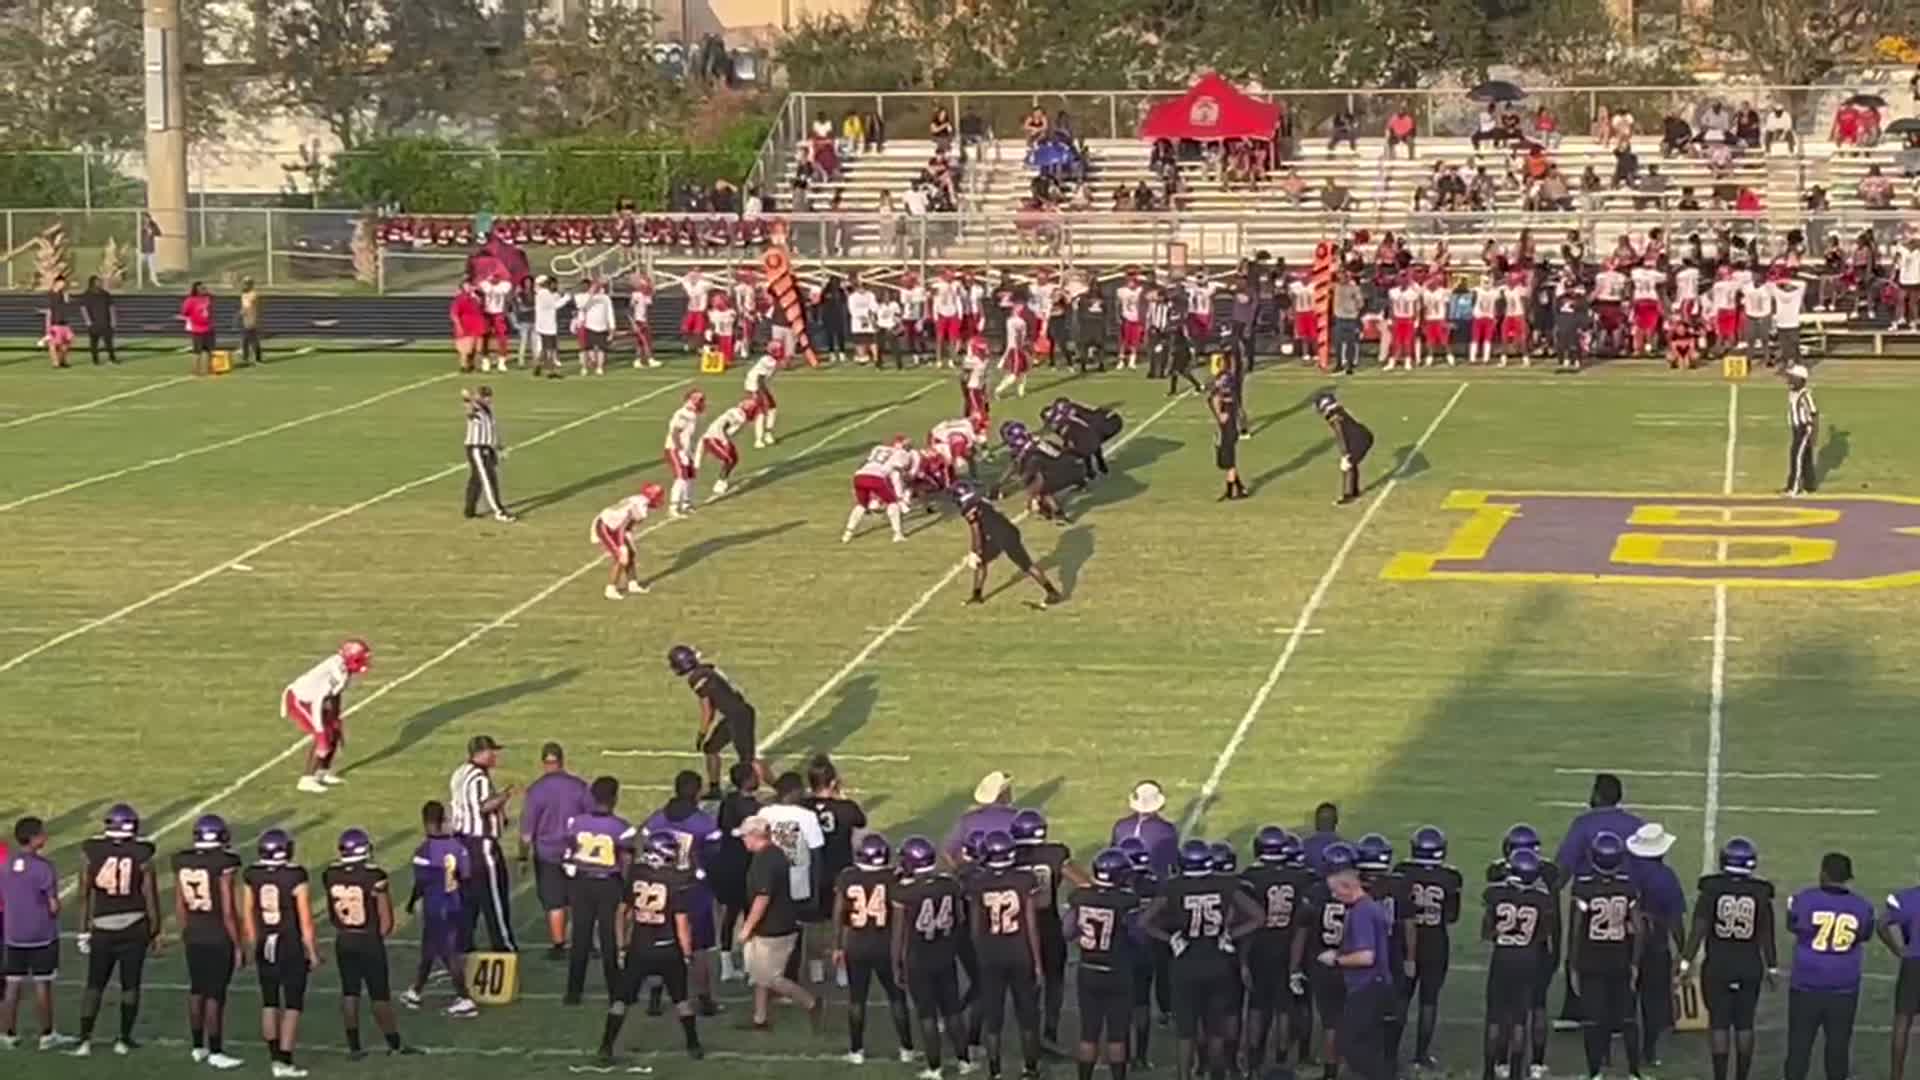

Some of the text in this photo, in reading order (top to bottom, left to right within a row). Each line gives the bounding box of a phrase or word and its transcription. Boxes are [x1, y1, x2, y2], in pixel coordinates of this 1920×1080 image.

[95, 856, 132, 896] 41
[846, 883, 887, 928] 34
[915, 895, 953, 941] 44
[983, 889, 1020, 935] 72
[1183, 893, 1222, 937] 75
[1495, 902, 1537, 946] 23
[1714, 894, 1756, 939] 99
[1078, 906, 1115, 951] 57
[1811, 910, 1859, 952] 76
[473, 958, 504, 996] 40
